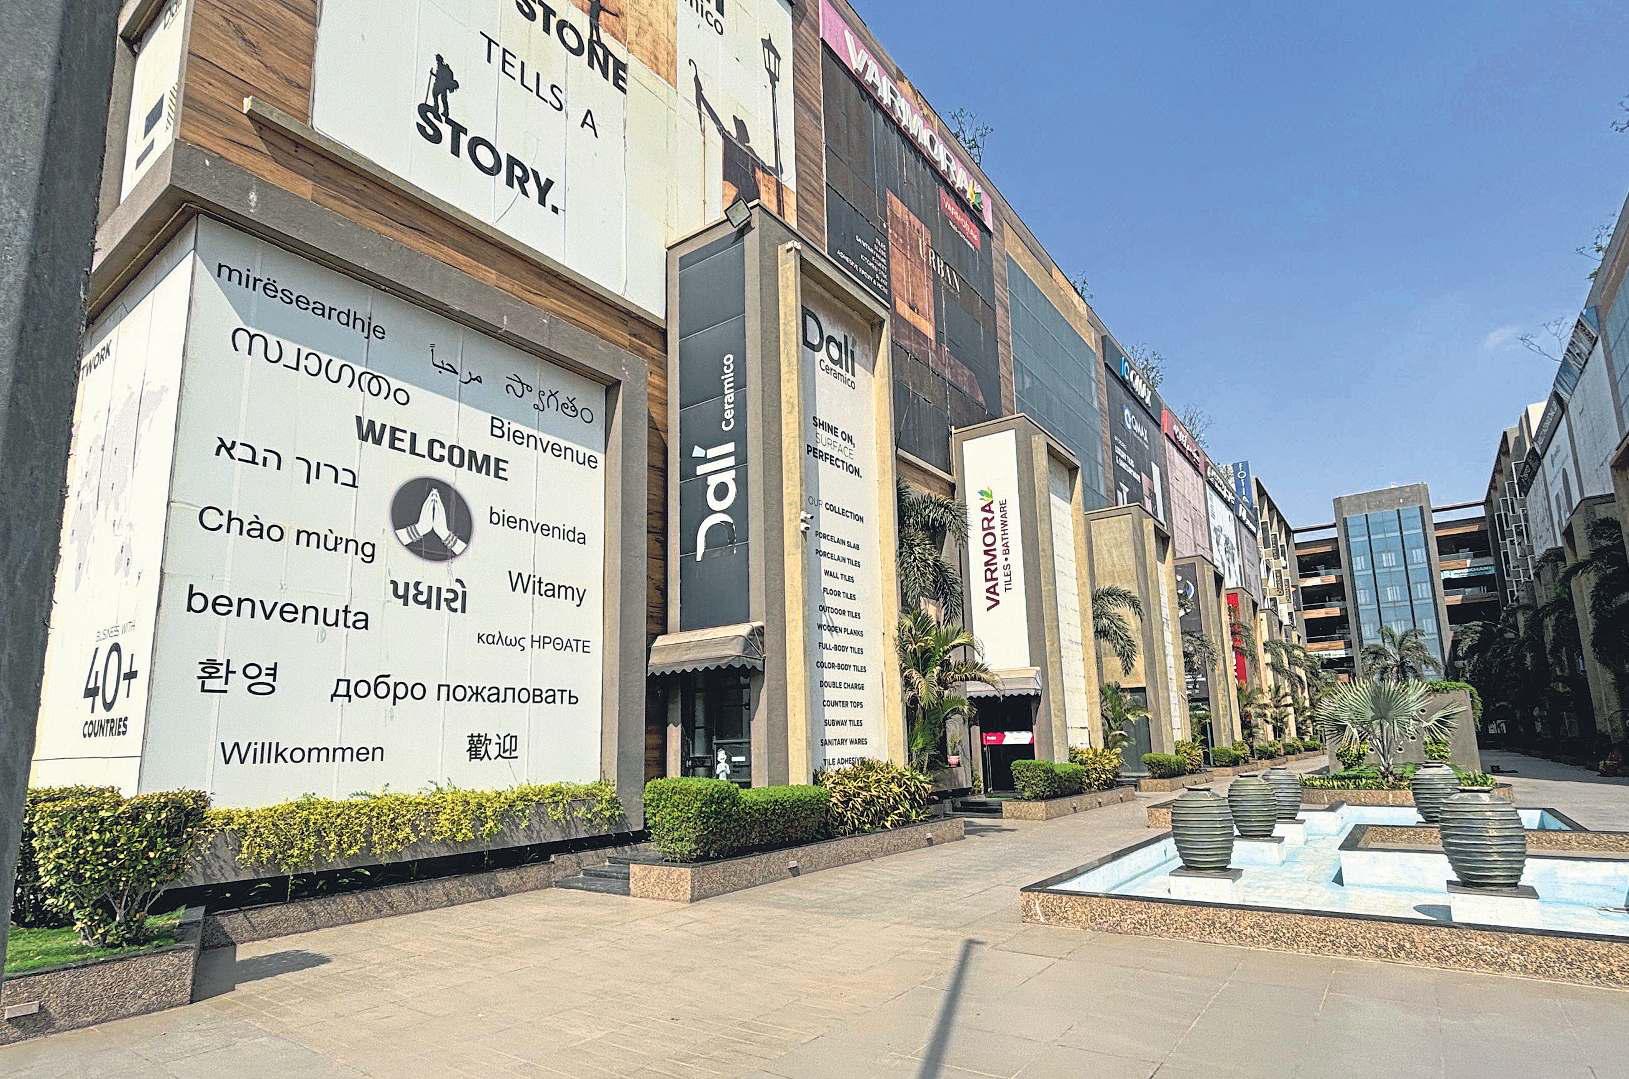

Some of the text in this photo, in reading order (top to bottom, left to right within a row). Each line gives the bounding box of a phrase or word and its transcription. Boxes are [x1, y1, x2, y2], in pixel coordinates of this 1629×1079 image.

[515, 0, 627, 95] STONE
[480, 31, 598, 138] TELLS A
[844, 29, 968, 190] VARMORA
[416, 103, 559, 214] STORY.
[217, 261, 386, 341] mirëseardhje
[801, 305, 857, 377] Dali
[232, 326, 412, 407] സ്വാഗതം
[819, 359, 856, 389] Ceramico
[721, 354, 734, 431] Ceramico
[355, 415, 509, 481] WELCOME
[490, 416, 598, 469] Bienvenue
[812, 416, 856, 448] SHINE ON,
[815, 432, 854, 460] SURFACE
[215, 437, 359, 491] ברוך הבא
[806, 444, 862, 478] PERFECTION.
[692, 441, 737, 561] Dali
[824, 502, 864, 523] COLLECTION
[199, 506, 376, 564] Chào mừng
[489, 506, 587, 545] bienvenida
[815, 531, 860, 551] PORCELAIN SLAB
[815, 549, 860, 568] PORCELAIN TILES
[981, 499, 1000, 612] VARMORA
[999, 498, 1012, 592] TILES BATHWARE
[508, 570, 586, 607] Witamy
[824, 569, 854, 583] WALL TILES
[187, 584, 368, 630] benvenuta
[390, 578, 467, 614] પધારો
[823, 587, 856, 601] FLOOR TILES
[818, 605, 861, 620] OUTDOOR TILES
[477, 631, 526, 651] καλως
[817, 622, 863, 638] WOODEN PLANKS
[818, 642, 863, 655] FULL-BODY TILES
[83, 642, 138, 713] 40+
[196, 658, 278, 696] 환영
[816, 660, 866, 673] COLOR-BODY TILES
[330, 674, 579, 706] добро пожаловать
[819, 680, 864, 690] DOUBLE CHARGE
[822, 700, 863, 709] COUNTER TOPS
[83, 716, 128, 738] COUNTRIES
[824, 719, 862, 727] SUBWAY TILES
[221, 742, 384, 765] Willkommen
[466, 733, 519, 762] 歡迎
[820, 738, 867, 747] SANITARY WARES
[823, 758, 836, 767] TILE
